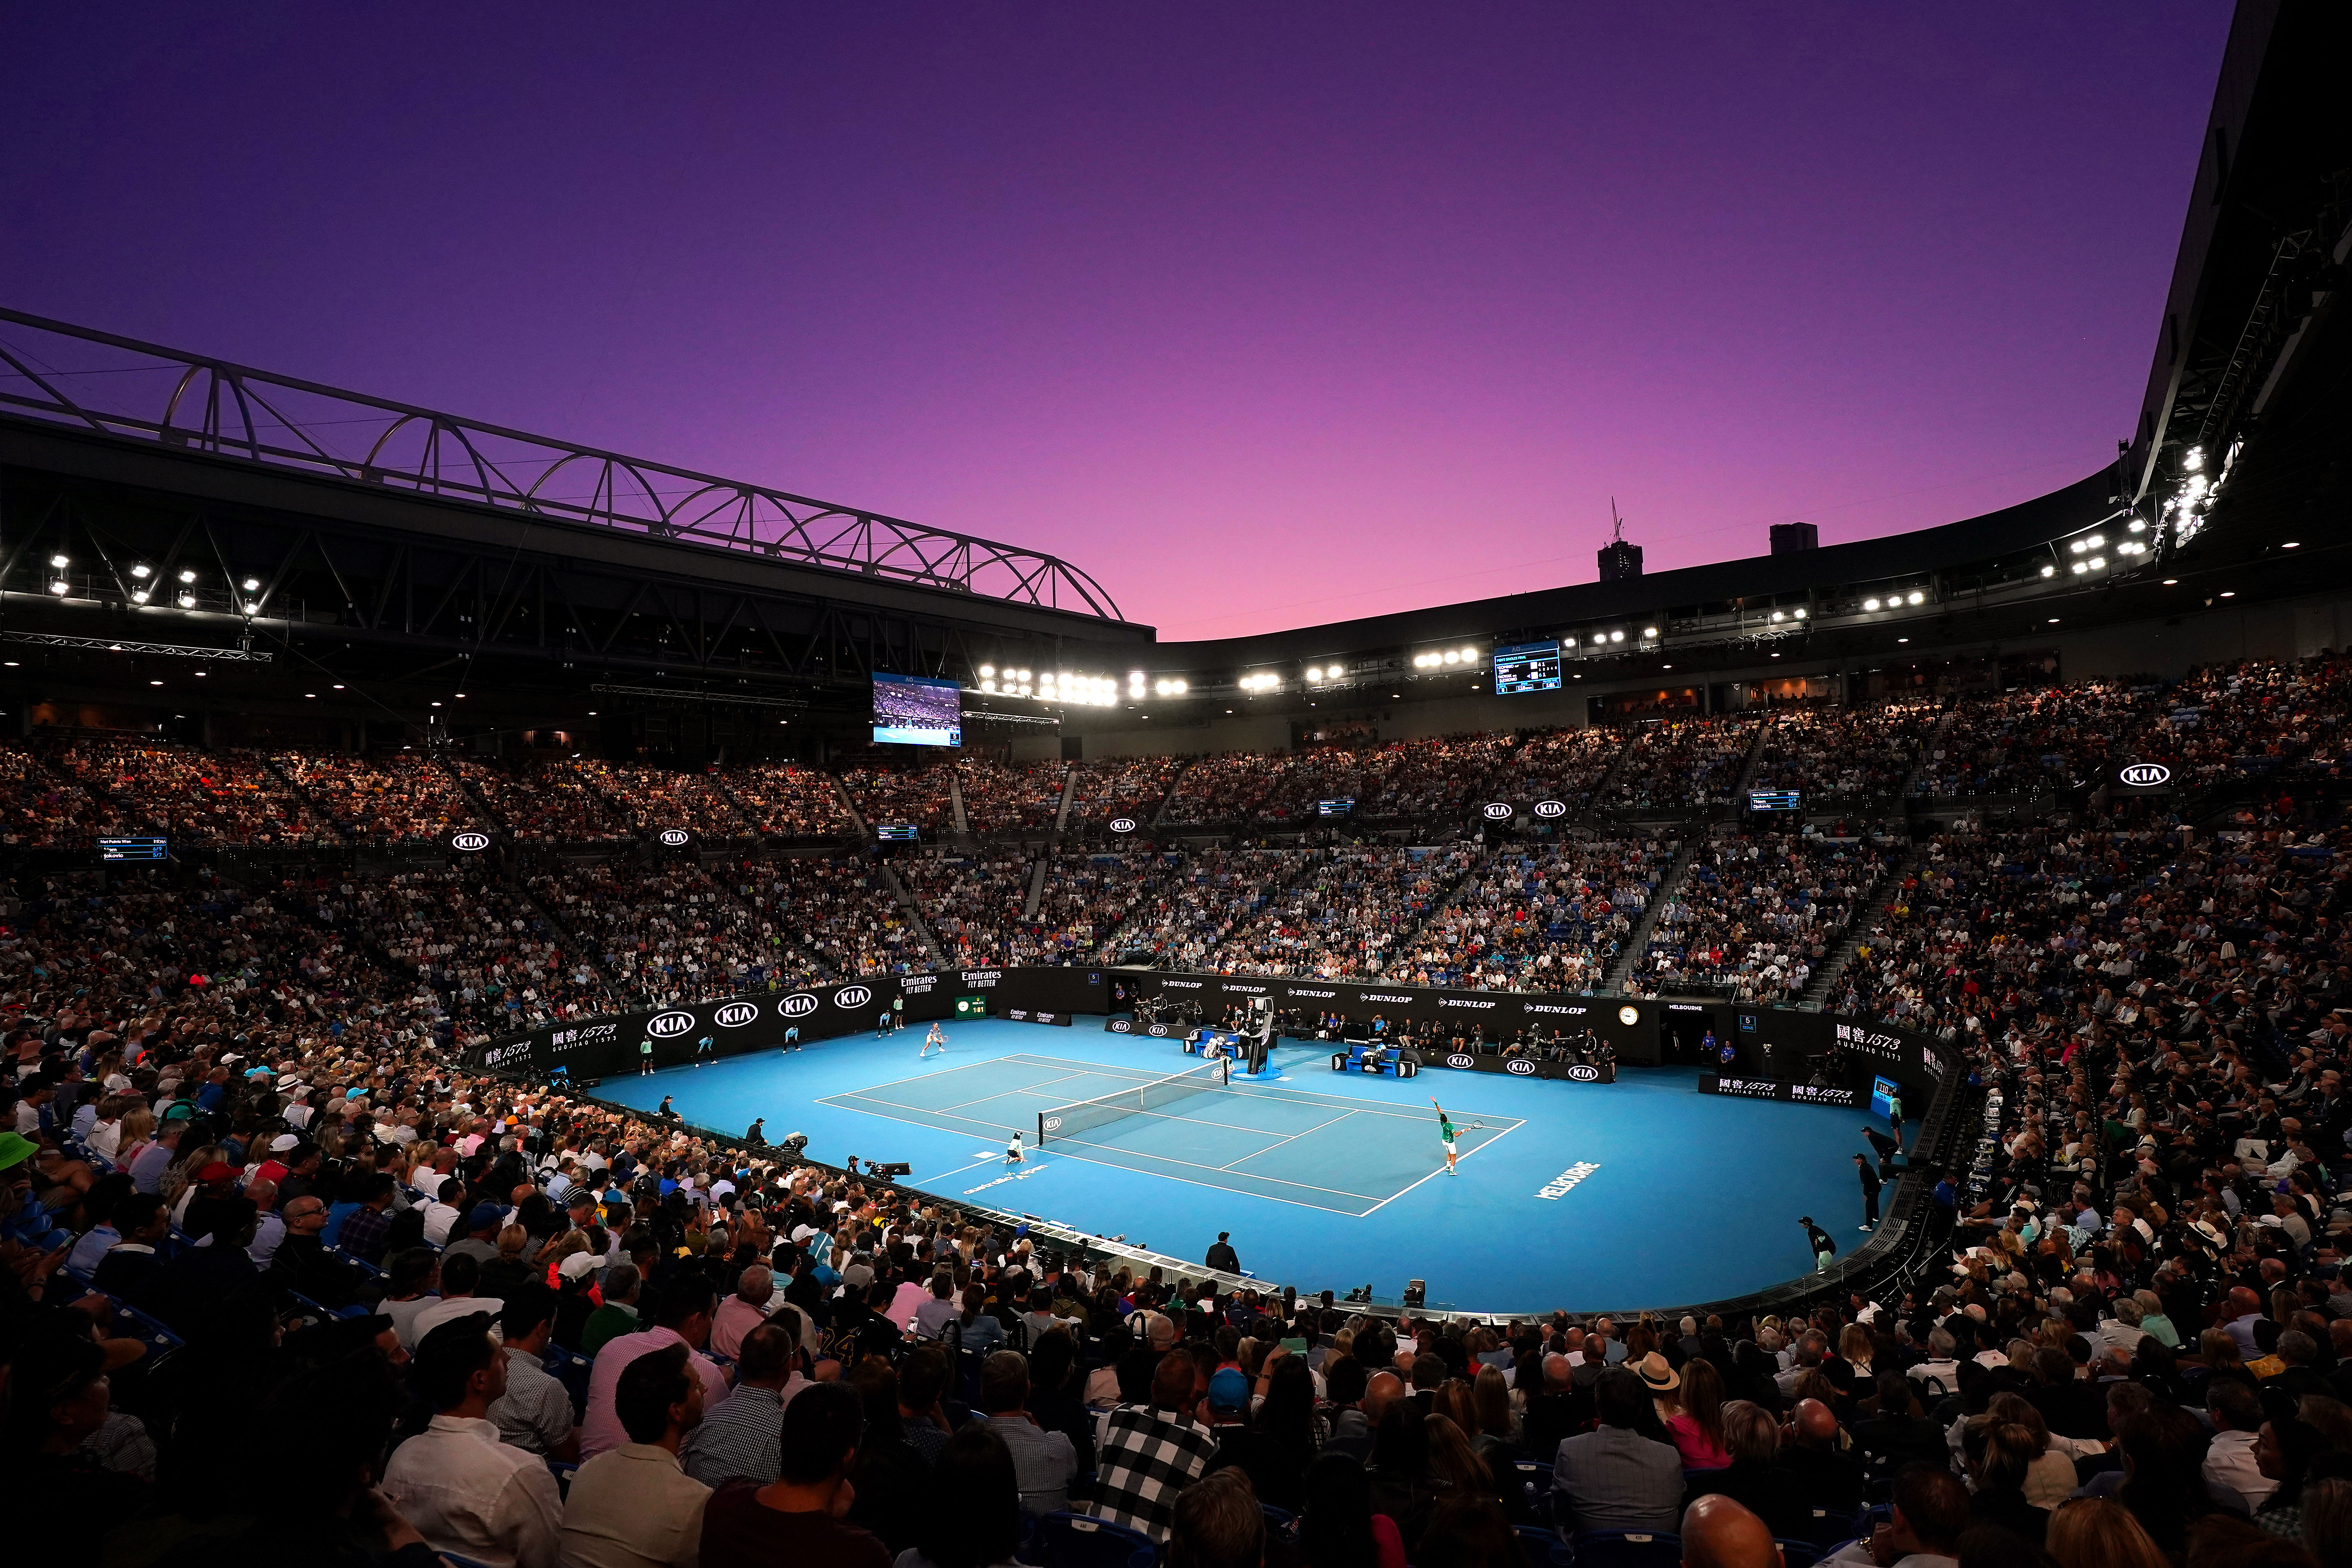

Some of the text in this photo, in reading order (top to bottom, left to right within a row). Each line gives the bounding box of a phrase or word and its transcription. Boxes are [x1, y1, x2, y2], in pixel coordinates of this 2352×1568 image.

[2129, 768, 2162, 781] KIA
[1488, 806, 1508, 816] KIA
[1540, 804, 1561, 814] KIA
[459, 837, 483, 847] KIA
[665, 833, 683, 842] KIA
[962, 971, 1001, 981] Emirates
[901, 976, 937, 987] Emirates
[968, 979, 996, 988] FLY BETTER
[914, 985, 932, 993] BETTER
[1229, 985, 1266, 993] DUNLOP
[1295, 990, 1336, 998] DUNLOP
[841, 990, 866, 1005] KIA
[1369, 994, 1413, 1003] DUNLOP
[785, 998, 811, 1013] KIA
[1448, 1000, 1495, 1009] DUNLOP
[722, 1007, 751, 1024] KIA
[1534, 1006, 1587, 1015] DUNLOP
[656, 1016, 688, 1033] KIA
[553, 1040, 588, 1052] GUOJIAO
[1837, 1040, 1901, 1061] GUOJIAO 1573
[515, 1054, 531, 1063] 1573
[1451, 1057, 1469, 1066] KIA
[1511, 1063, 1530, 1072] KIA
[1573, 1069, 1593, 1078] KIA
[1879, 1083, 1888, 1095] 110
[1046, 1119, 1058, 1129] KIA
[1019, 1164, 1049, 1175] open
[1533, 1161, 1601, 1200] MELBOURNE
[821, 1326, 855, 1367] 24
